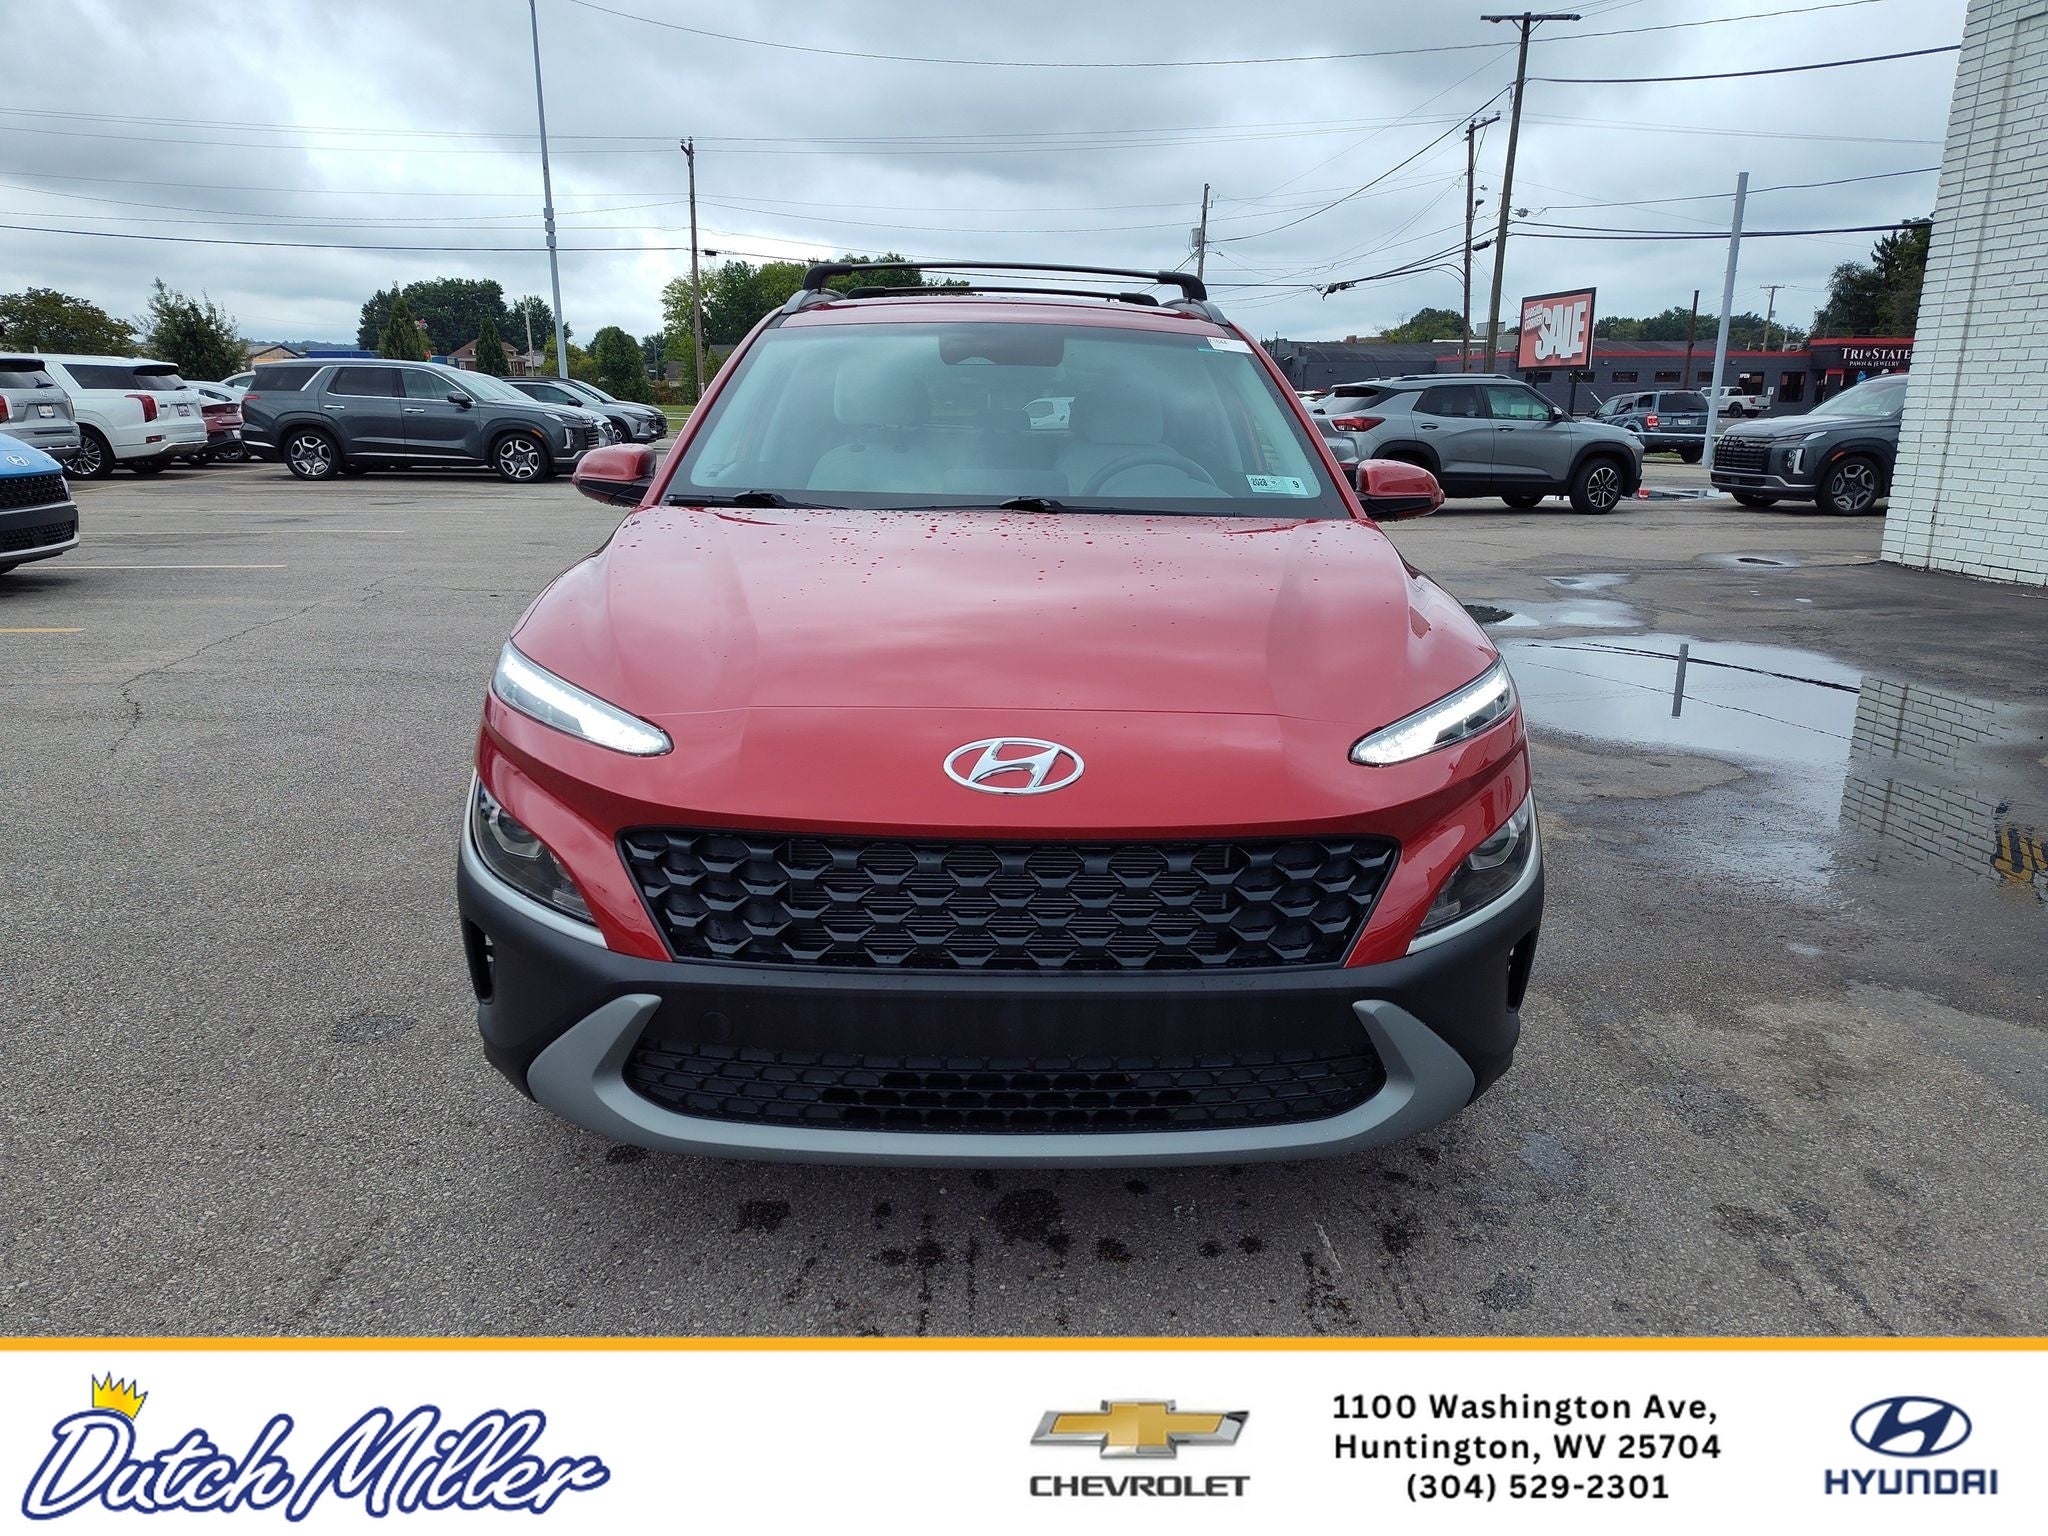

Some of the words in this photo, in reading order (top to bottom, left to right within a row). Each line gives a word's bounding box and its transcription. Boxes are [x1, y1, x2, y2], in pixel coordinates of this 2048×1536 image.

[1535, 301, 1586, 360] SALE
[1841, 347, 1864, 360] TRI
[1871, 347, 1911, 360] STATE
